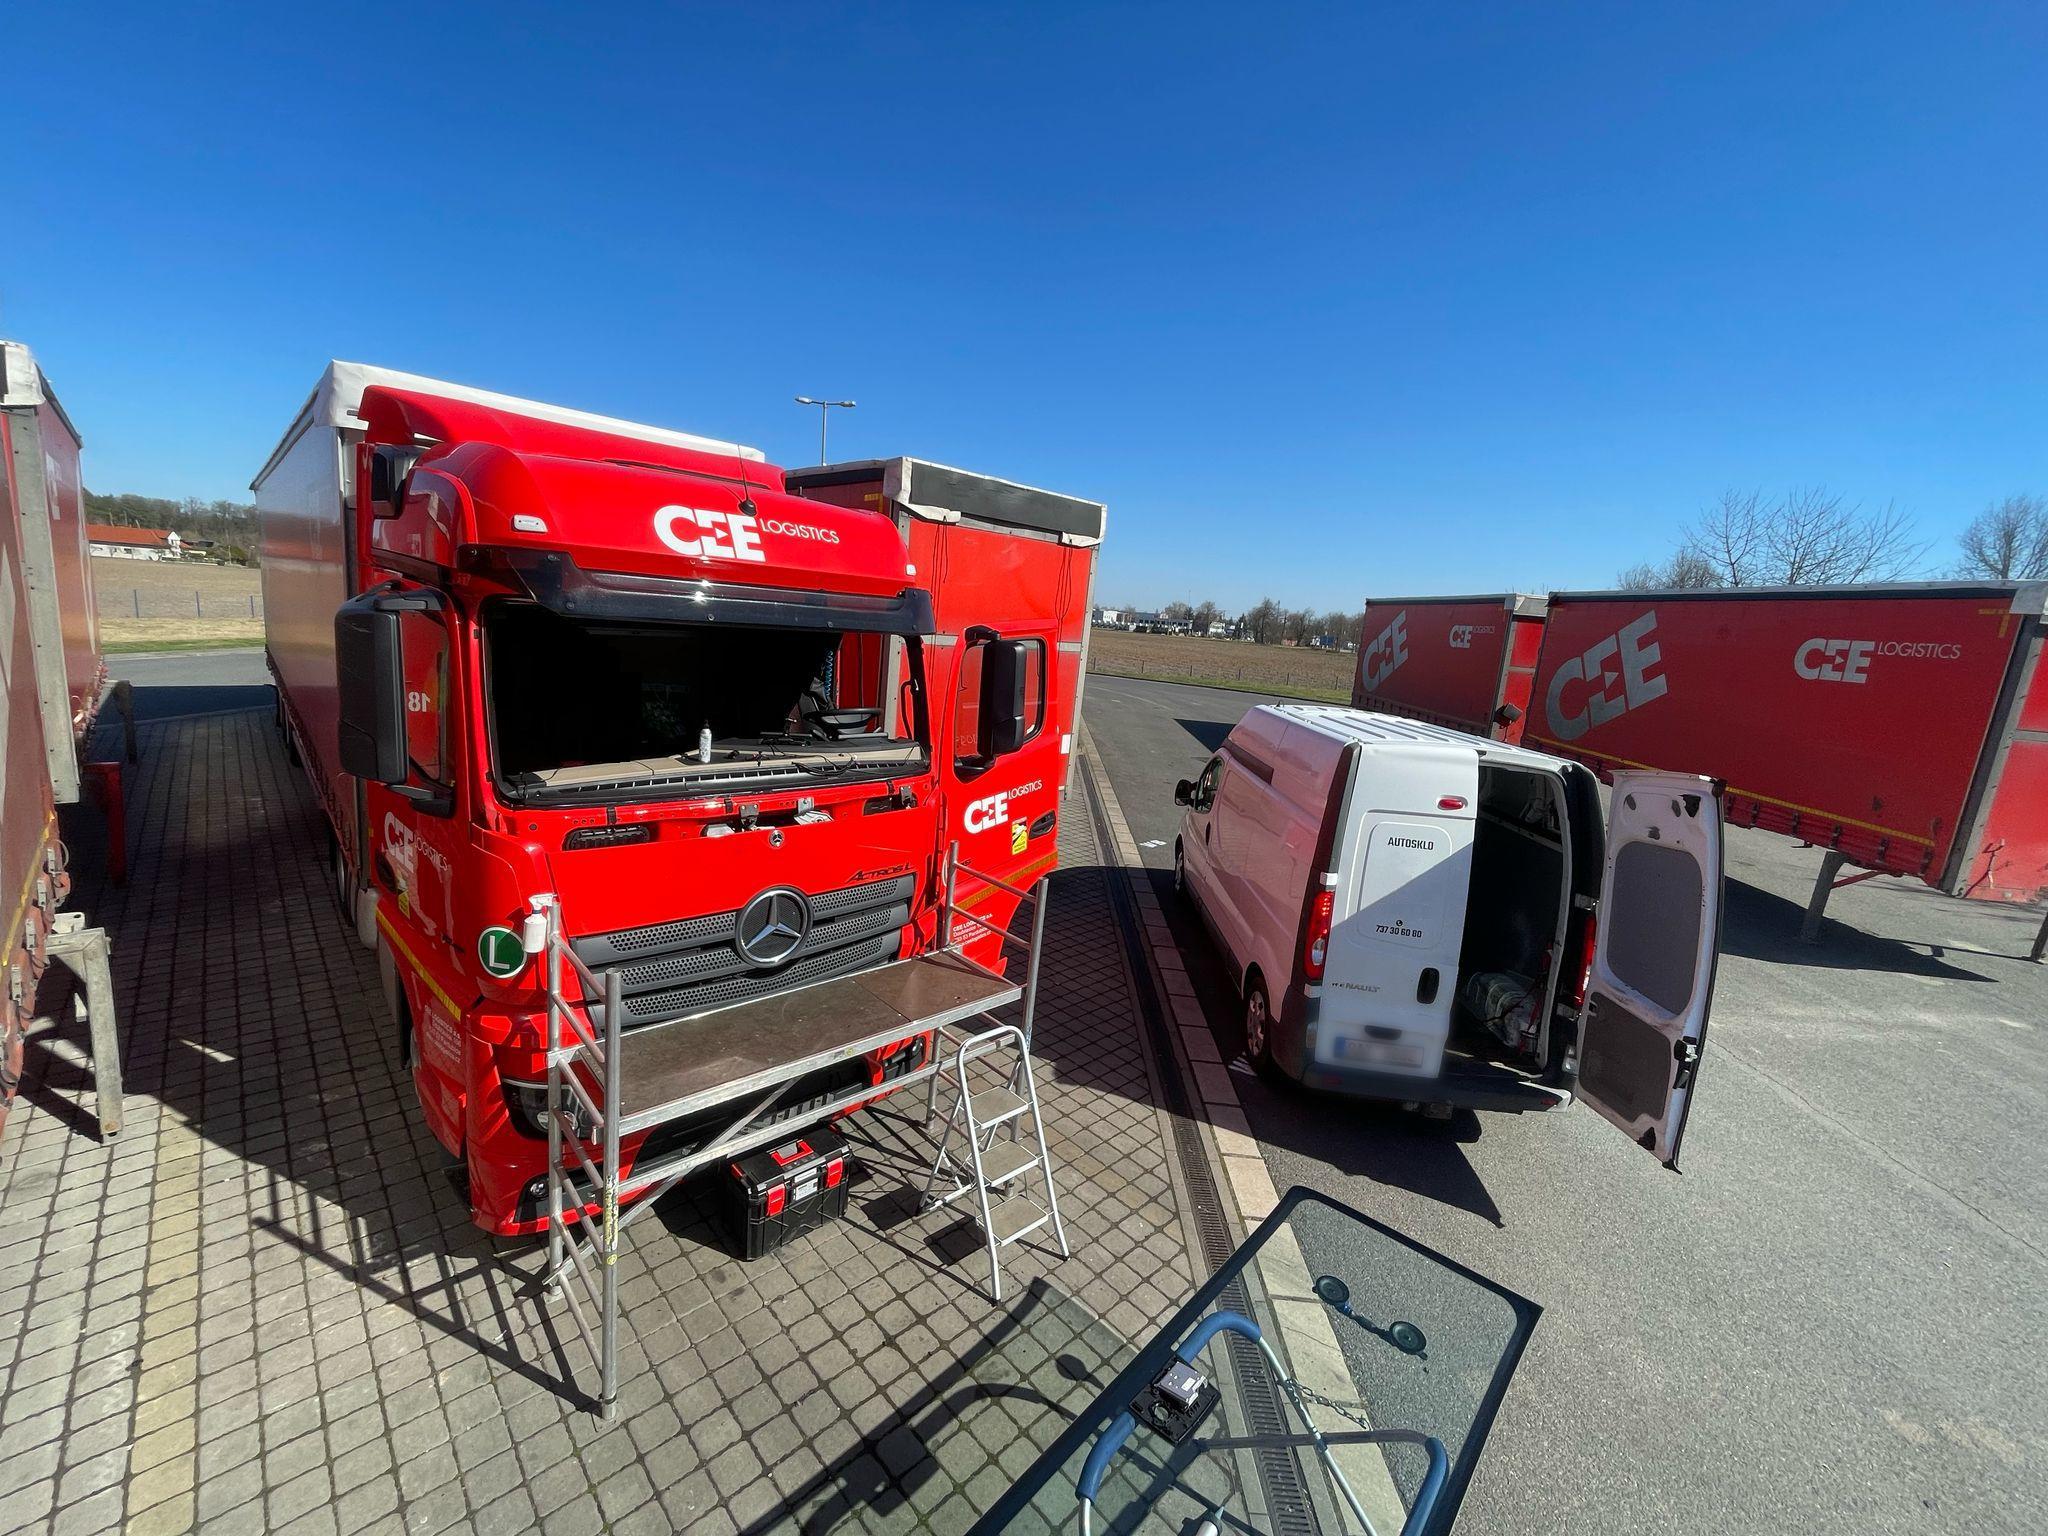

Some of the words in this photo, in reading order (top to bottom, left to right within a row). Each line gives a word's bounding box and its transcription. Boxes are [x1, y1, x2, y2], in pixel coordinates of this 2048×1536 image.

[653, 505, 766, 562] CEE
[759, 518, 840, 544] LOGISTICS
[1362, 610, 1409, 692] CEE
[1449, 625, 1473, 648] CEE
[1793, 638, 1875, 684] CEE
[1877, 641, 1962, 659] LOGISTICS
[1546, 609, 1668, 740] CEE
[963, 791, 1008, 834] CEE
[1008, 780, 1043, 799] LOGISTICS
[384, 811, 414, 873] CEE
[1387, 836, 1434, 850] AUTOSKLO
[489, 935, 510, 969] L
[1375, 924, 1389, 933] 737
[1389, 927, 1400, 935] 30
[1411, 929, 1422, 938] 80
